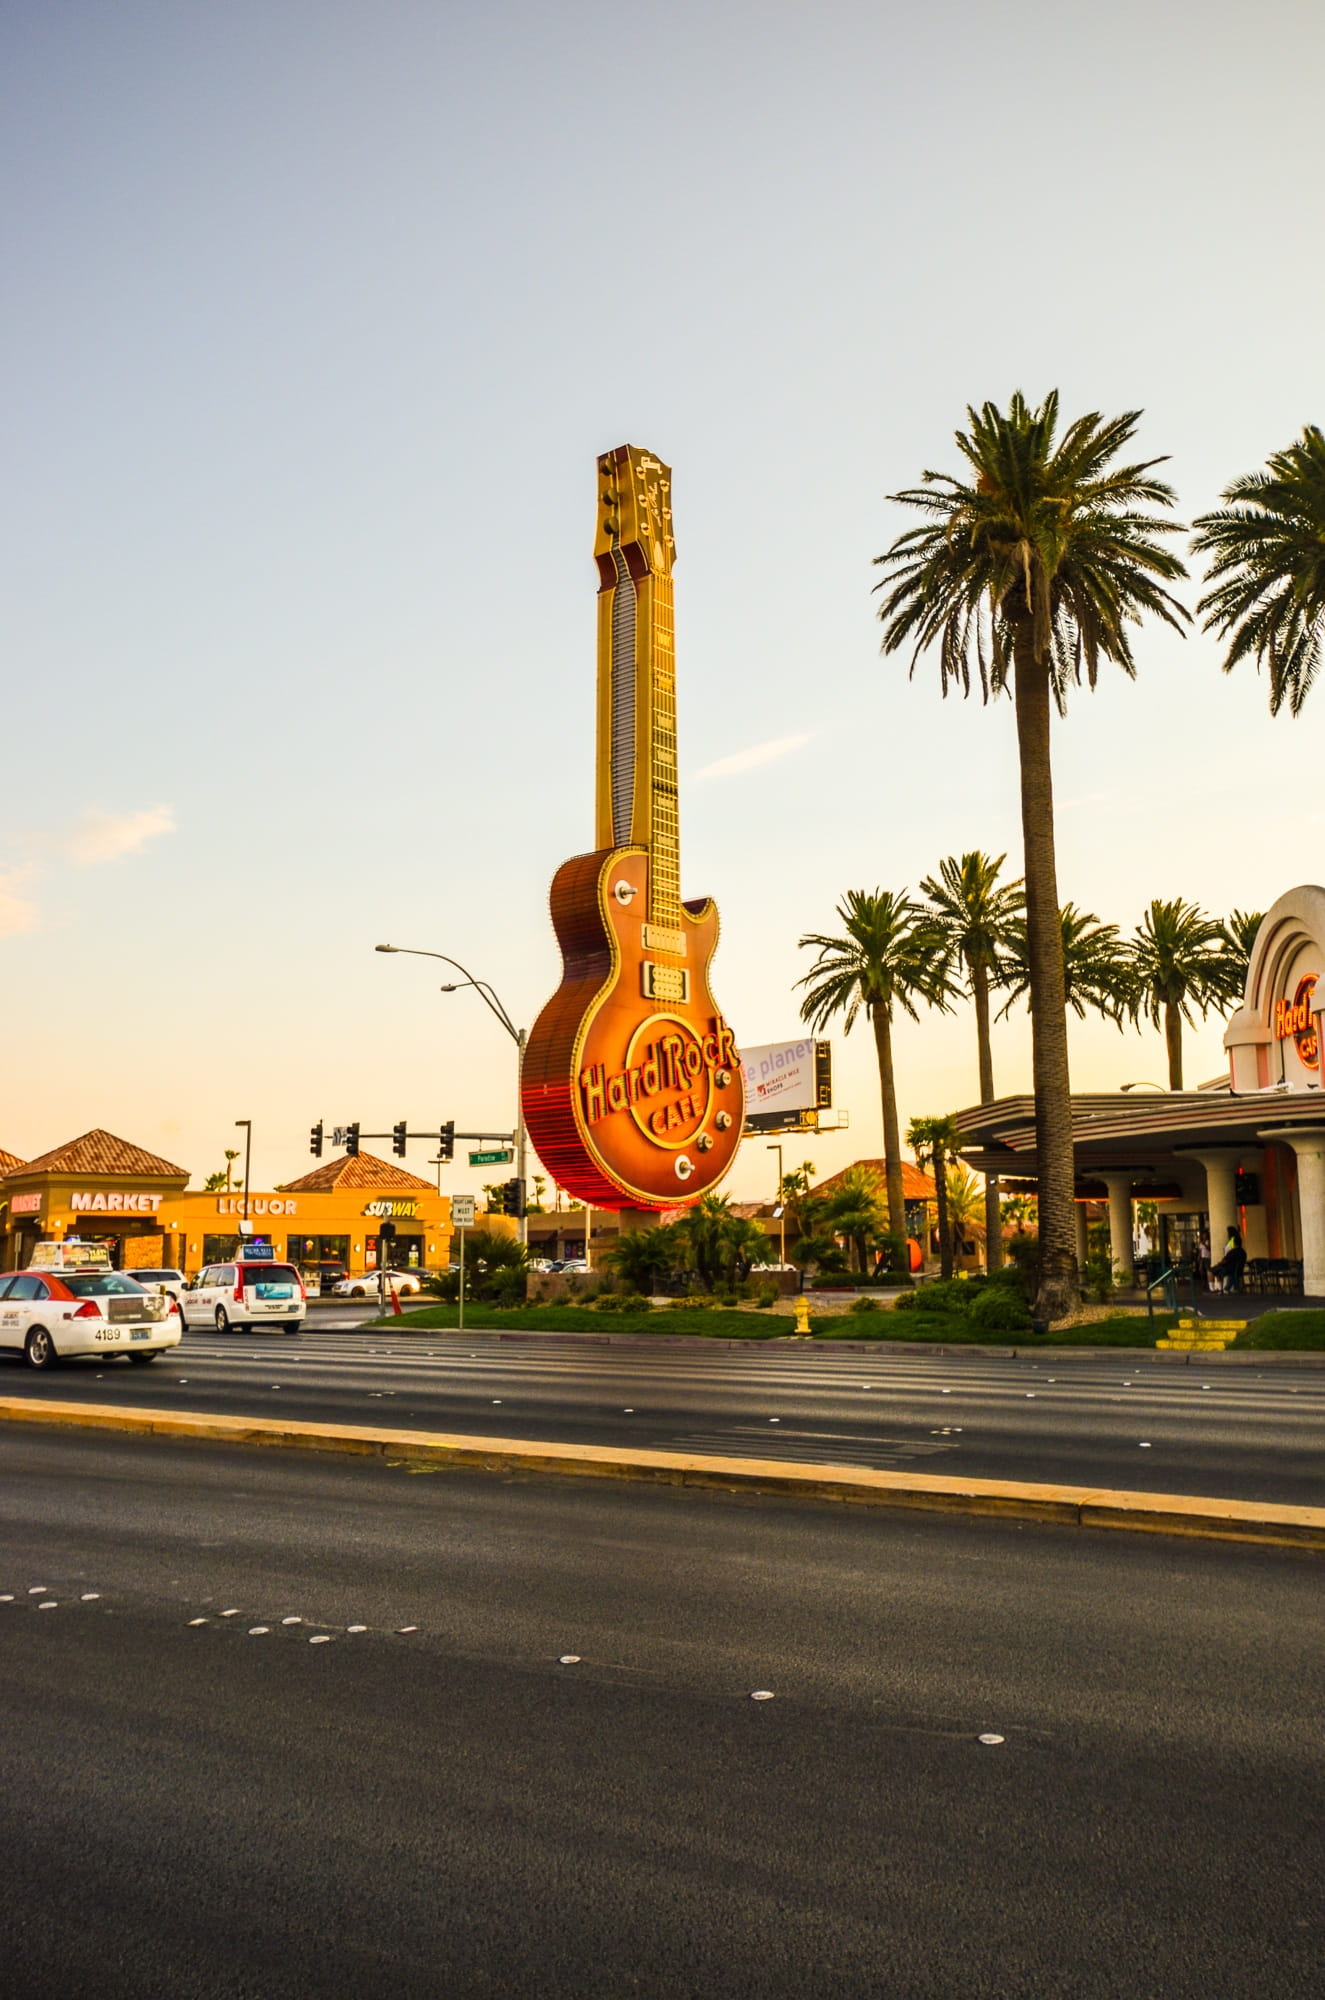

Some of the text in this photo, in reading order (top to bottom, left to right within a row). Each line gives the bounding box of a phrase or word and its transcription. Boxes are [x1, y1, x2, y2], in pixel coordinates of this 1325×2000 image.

[1275, 993, 1308, 1041] Hard
[1300, 1037, 1317, 1057] CAF
[760, 1039, 814, 1080] planet
[583, 1016, 740, 1125] Hard Rock
[651, 1093, 704, 1135] CAFE
[71, 1193, 163, 1211] MARKET
[217, 1199, 297, 1215] LIQUOR
[368, 1202, 421, 1216] SUBWAY
[95, 1328, 121, 1341] 4189
